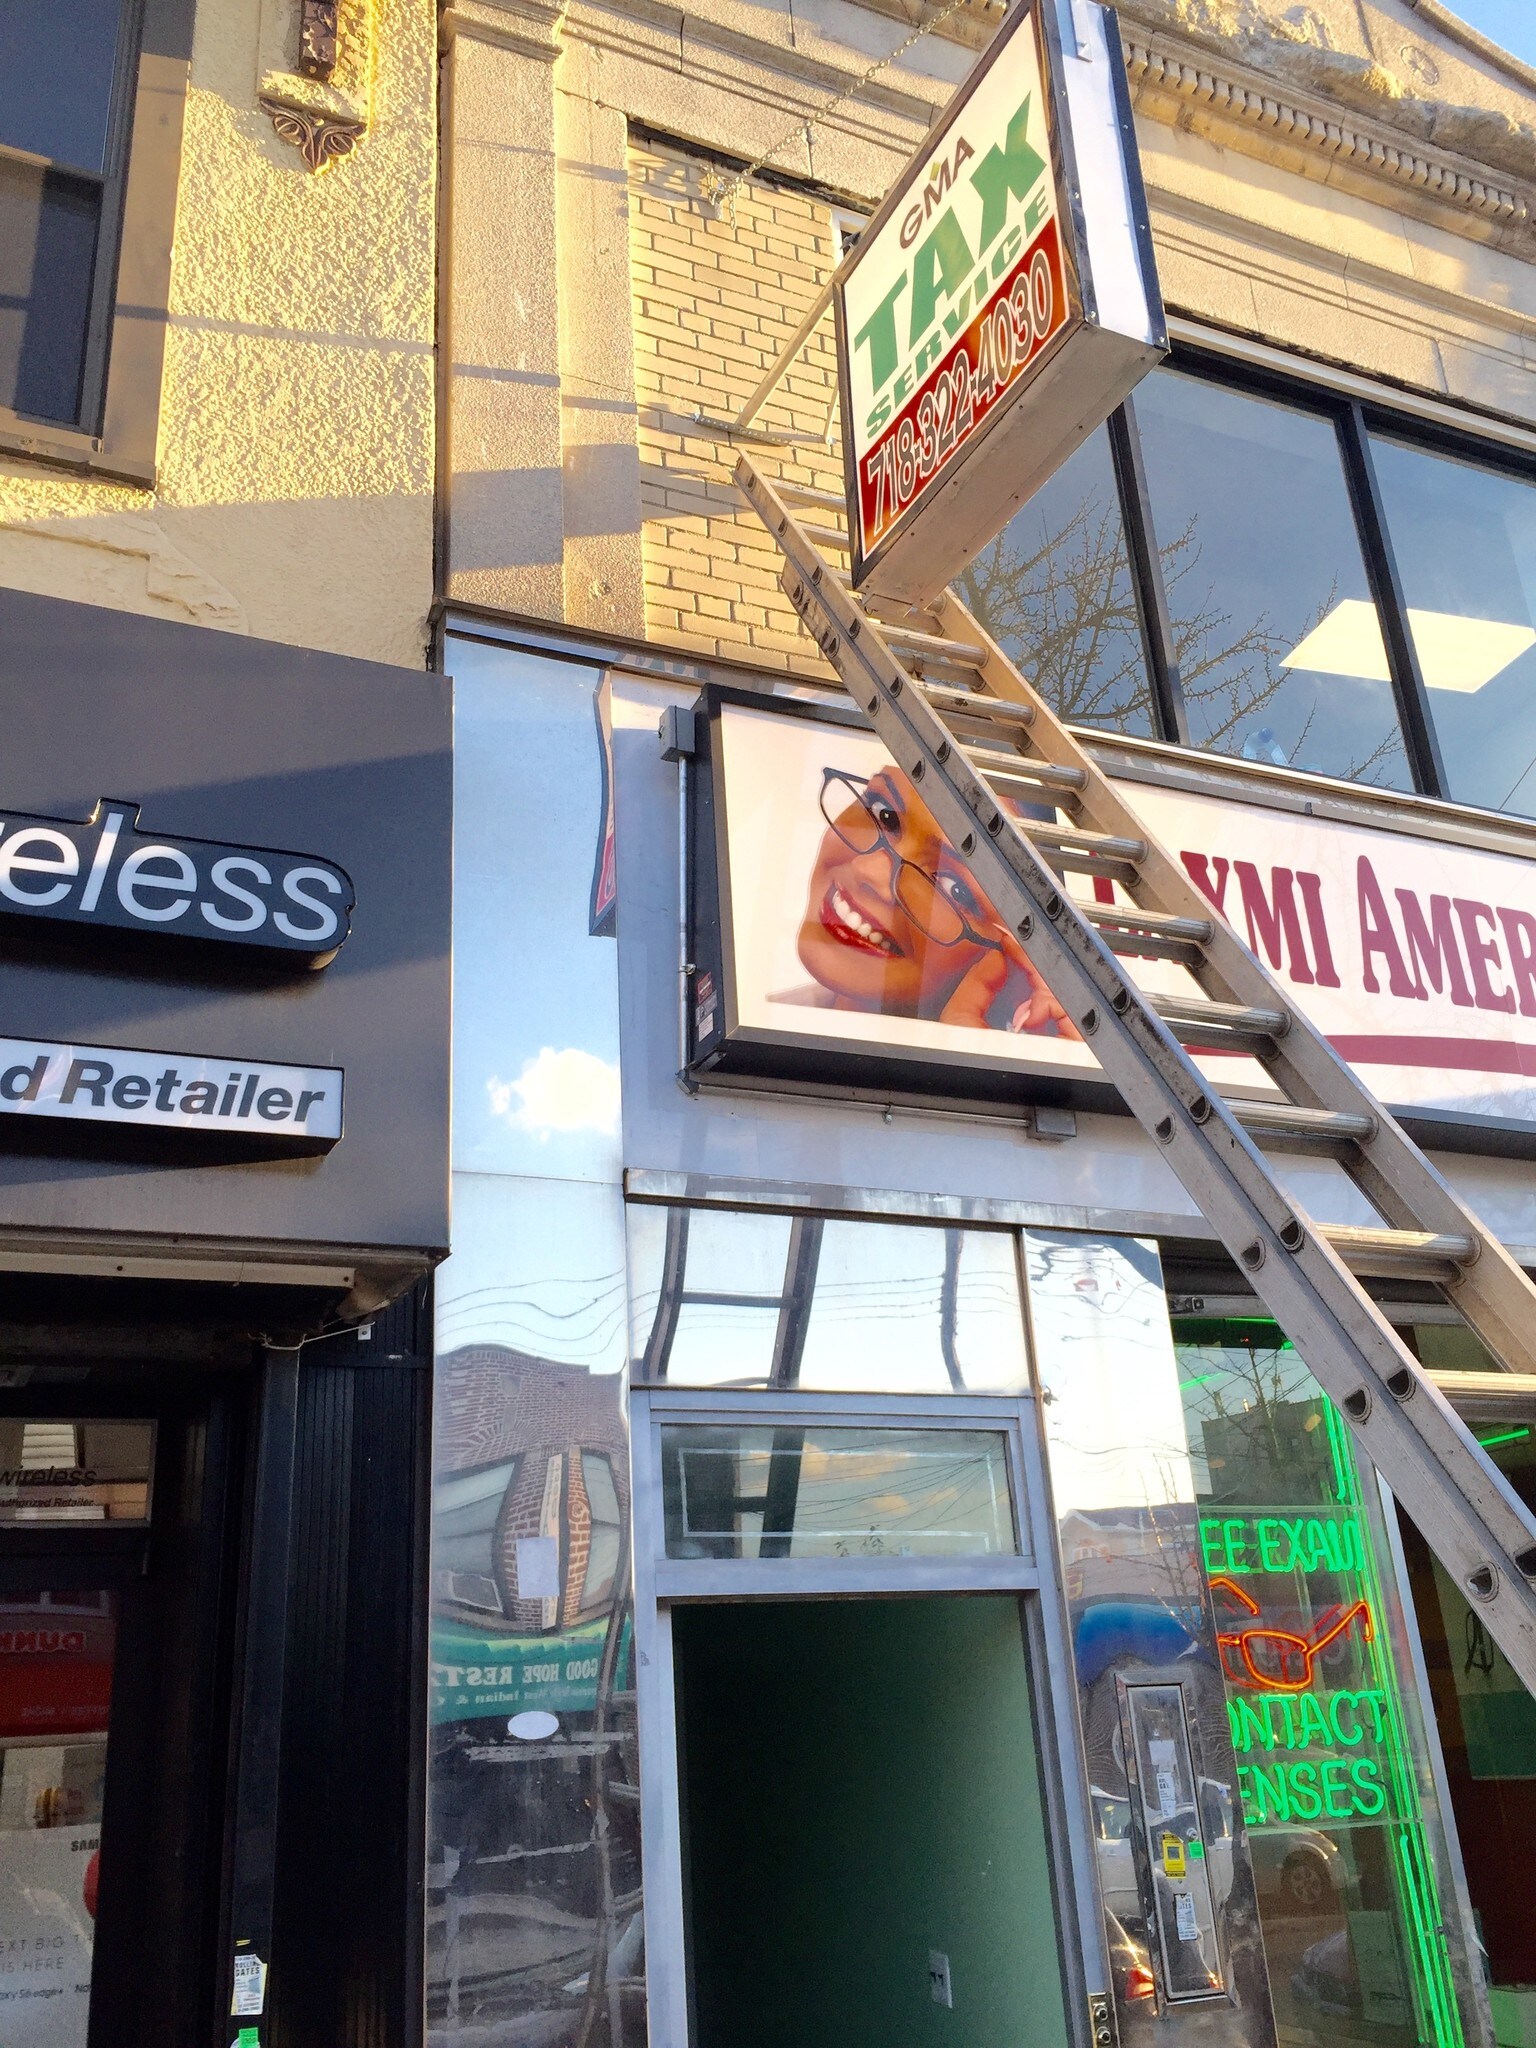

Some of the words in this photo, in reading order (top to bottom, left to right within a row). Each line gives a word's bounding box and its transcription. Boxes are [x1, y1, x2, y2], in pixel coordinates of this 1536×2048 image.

[855, 91, 1046, 396] TAX
[900, 136, 974, 252] GMA
[867, 185, 1048, 439] SERVICE
[867, 248, 1053, 536] 718-322-4030
[0, 812, 343, 942] eless
[58, 1059, 326, 1122] Retailer
